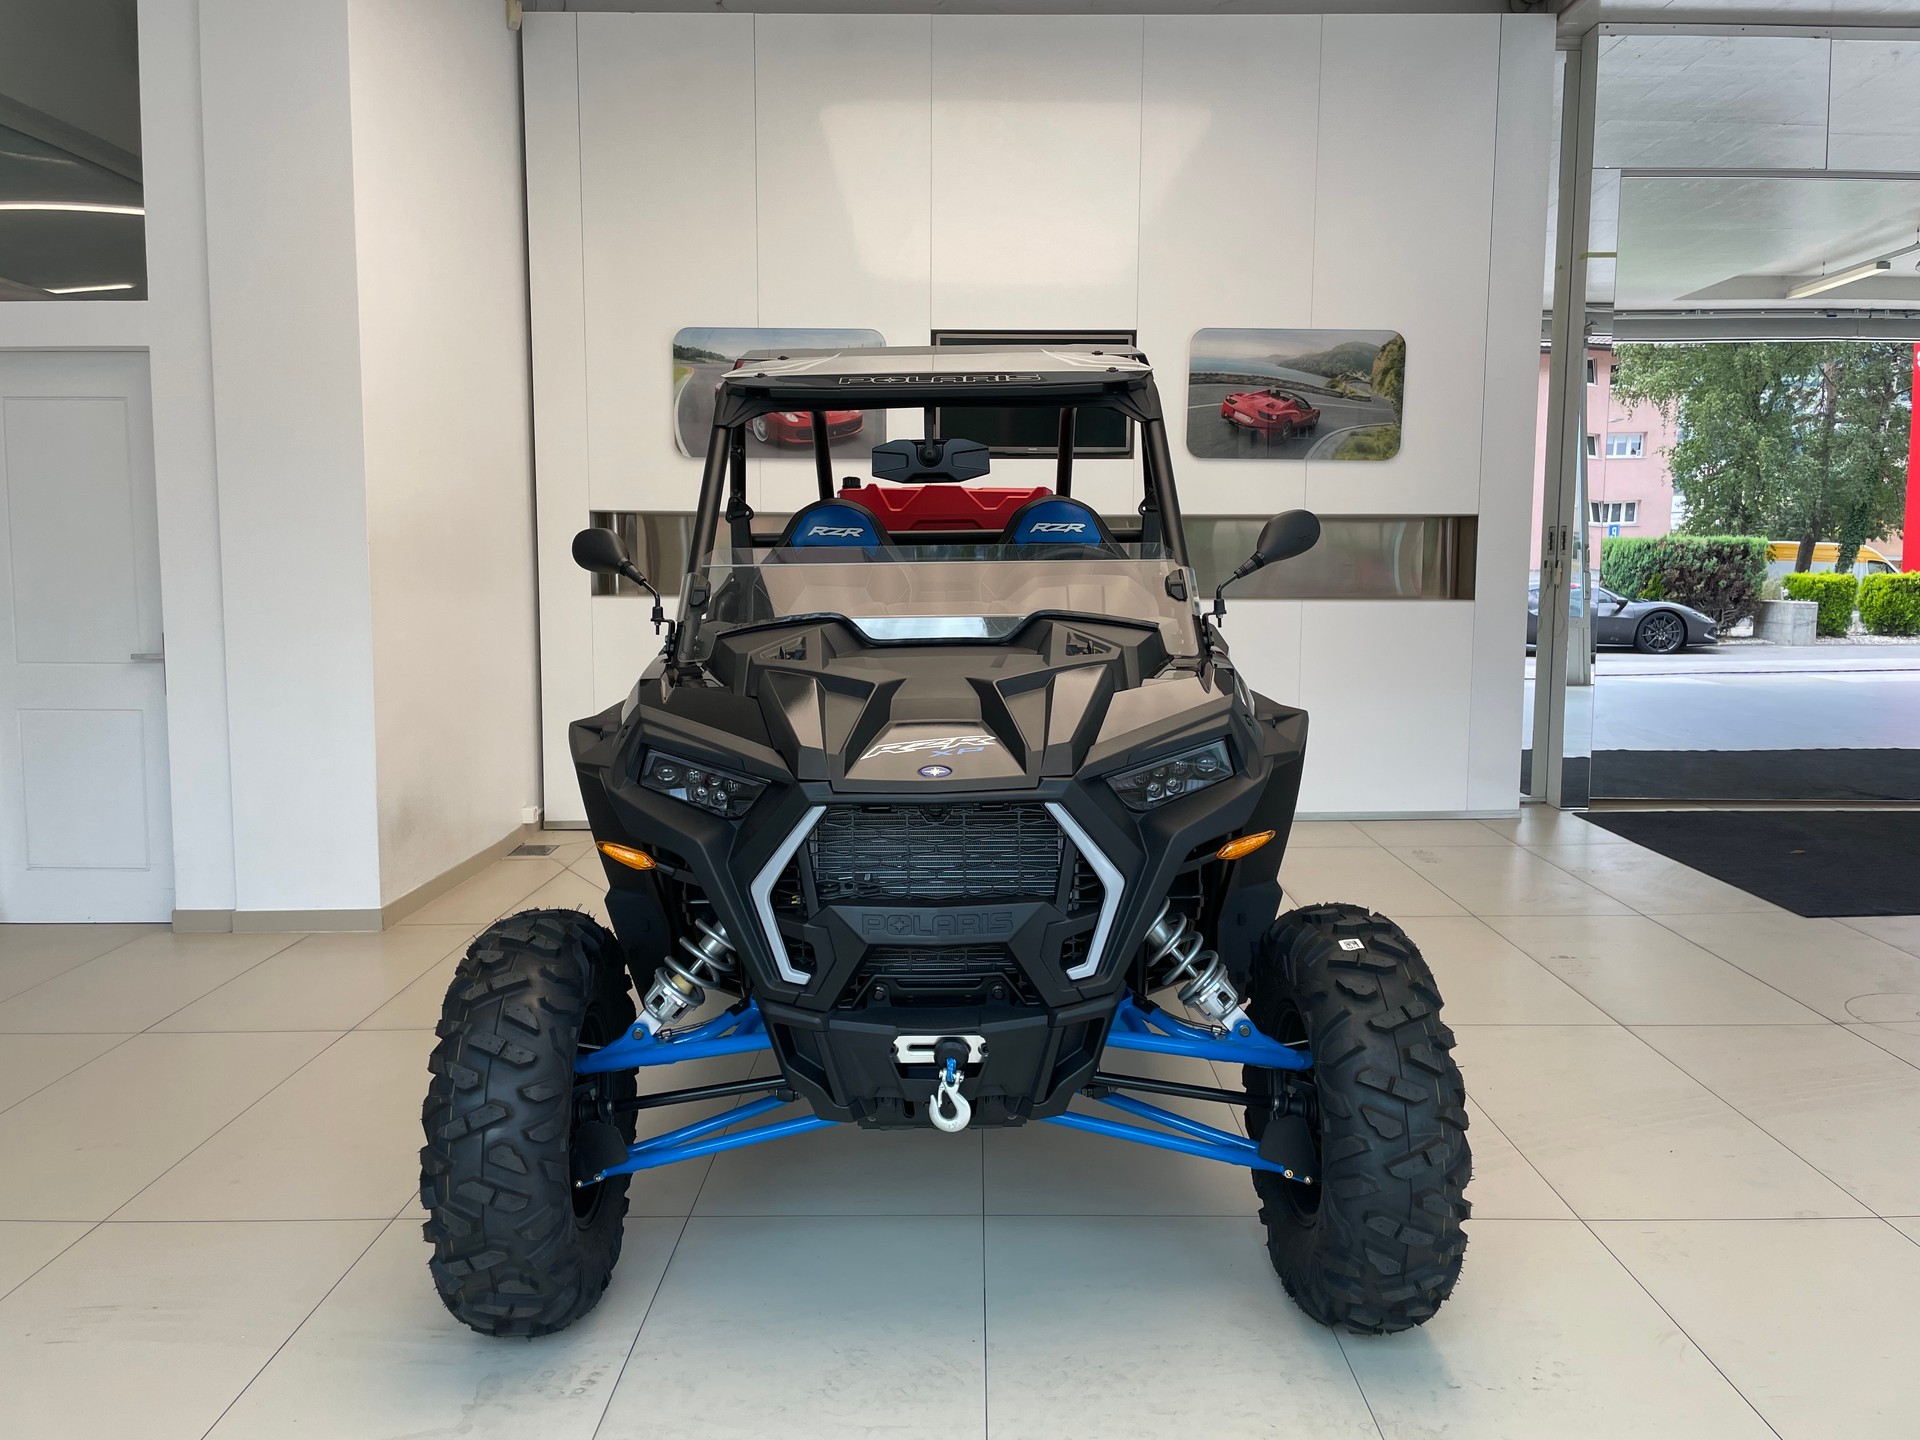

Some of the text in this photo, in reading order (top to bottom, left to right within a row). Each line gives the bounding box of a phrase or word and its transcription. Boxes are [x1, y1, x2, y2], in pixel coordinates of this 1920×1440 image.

[838, 374, 1041, 385] POLARIS
[808, 526, 864, 538] RZR
[1030, 522, 1086, 533] RZR
[860, 735, 997, 760] RZR
[929, 746, 985, 757] XP
[861, 911, 1014, 936] POLARIS
